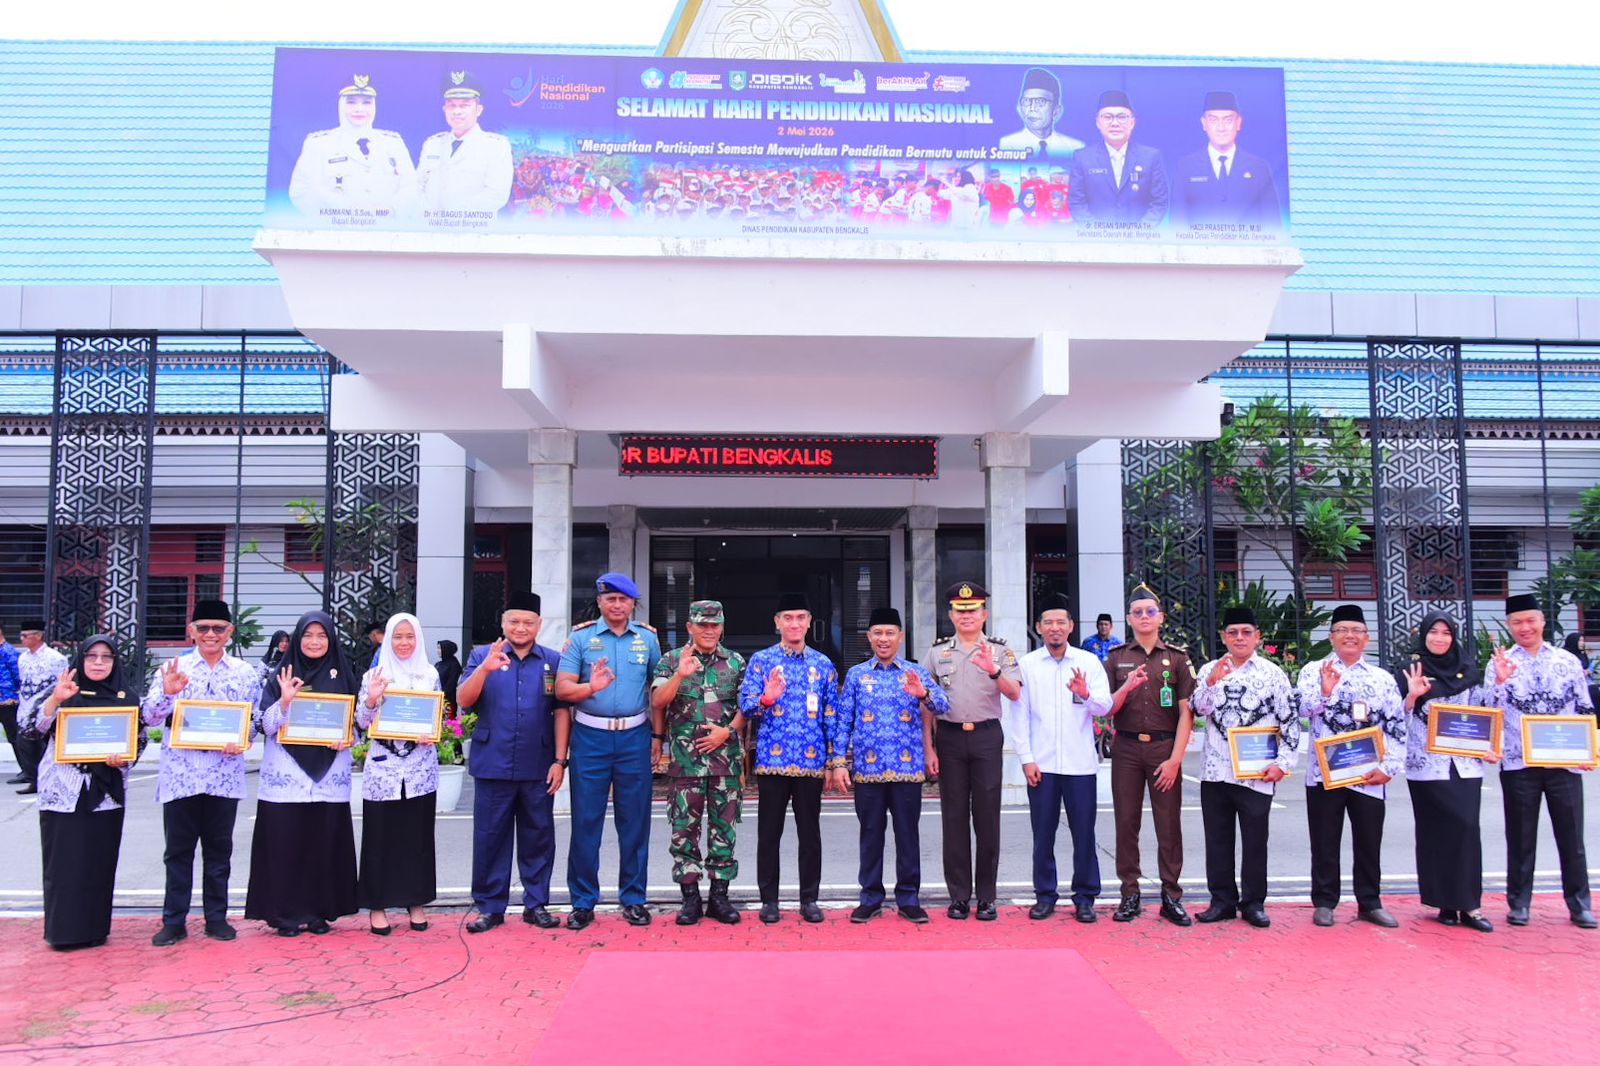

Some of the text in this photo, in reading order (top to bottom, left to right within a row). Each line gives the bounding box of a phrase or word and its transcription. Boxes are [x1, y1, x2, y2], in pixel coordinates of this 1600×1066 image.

[541, 74, 564, 84] Hari
[752, 73, 814, 85] DISDIK
[541, 83, 606, 93] Pendidikan
[540, 91, 590, 101] Nasional
[617, 97, 994, 124] SELAMAT HARI PENDIDIKAN NASIONAL
[777, 126, 834, 136] 2 Mei 2026
[656, 141, 715, 156] Partisipasi
[718, 142, 764, 156] Semesta
[767, 143, 838, 158] Mewujudkan
[841, 144, 903, 158] Pendidikan
[906, 146, 953, 159] Bermutu
[956, 147, 988, 159] untuk
[441, 210, 463, 218] BAGUS
[464, 211, 494, 219] SANTOSO
[741, 225, 869, 234] DINAS PENDIDIKAN KABUPATEN BENGKALIS
[1115, 222, 1142, 230] SAPUTRA
[647, 447, 717, 465] BUPATI
[722, 447, 833, 466] BENGKALIS
